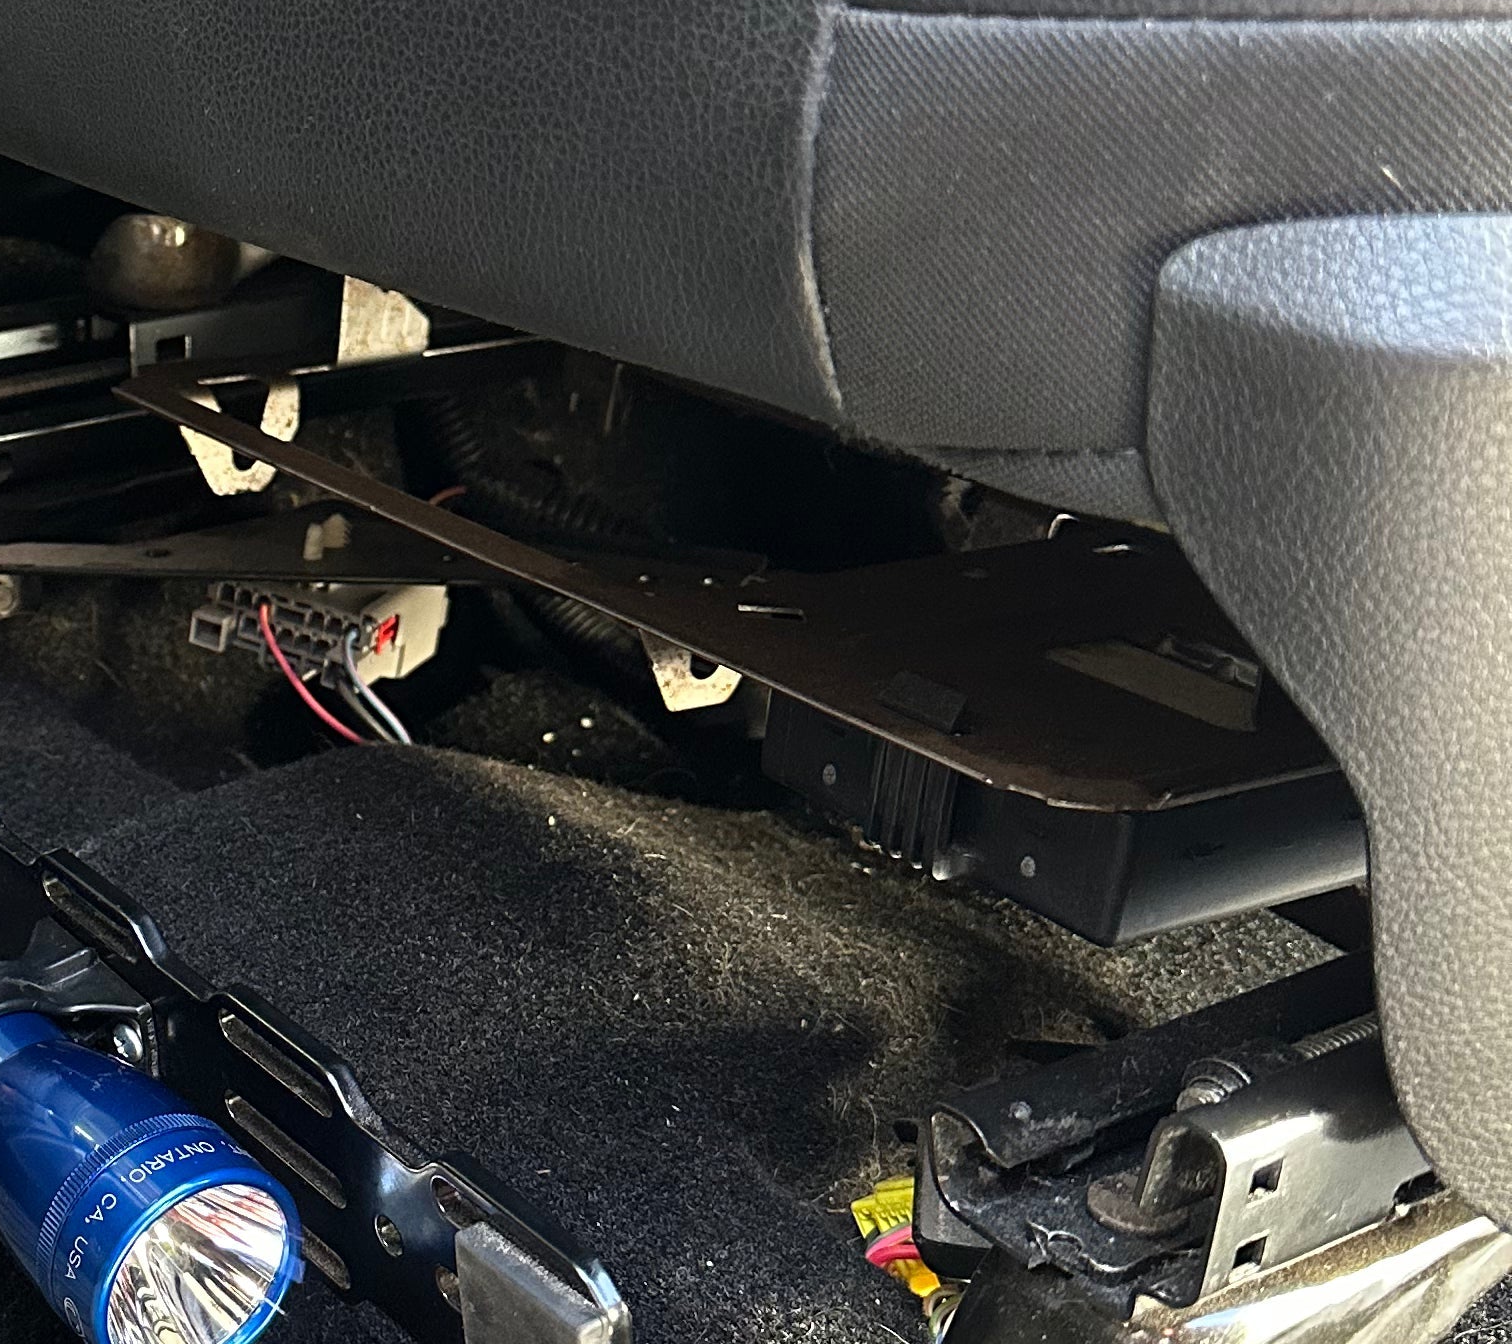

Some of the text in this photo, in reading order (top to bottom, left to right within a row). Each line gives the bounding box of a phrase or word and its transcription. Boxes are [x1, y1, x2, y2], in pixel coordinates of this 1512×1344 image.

[64, 1140, 216, 1281] ONTARIO, CA, USA
